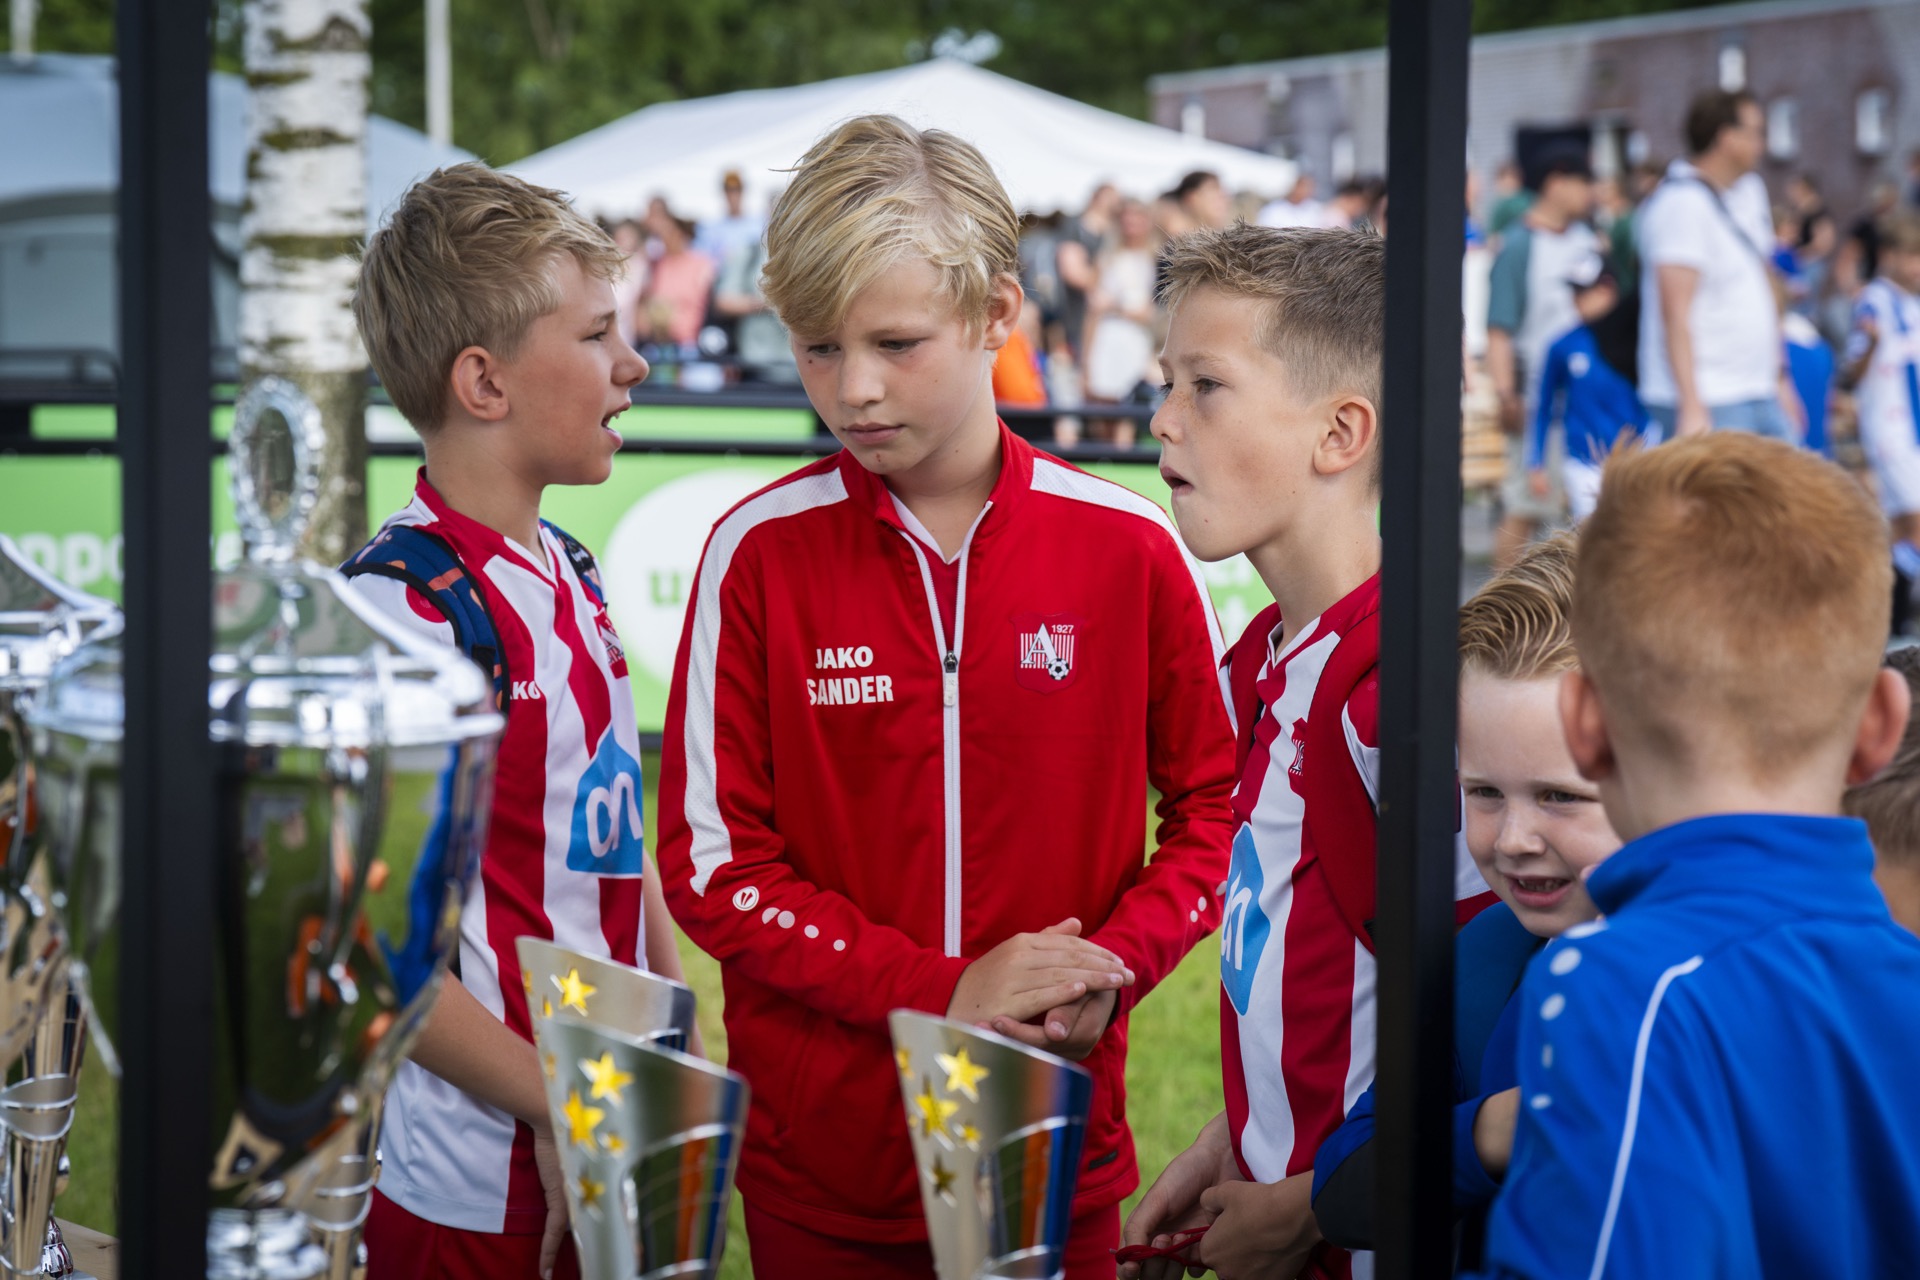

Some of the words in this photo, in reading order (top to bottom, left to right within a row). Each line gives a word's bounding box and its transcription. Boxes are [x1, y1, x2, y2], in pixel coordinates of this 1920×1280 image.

[1051, 624, 1075, 634] 1927
[815, 645, 874, 670] JAKO
[806, 674, 894, 706] SANDER
